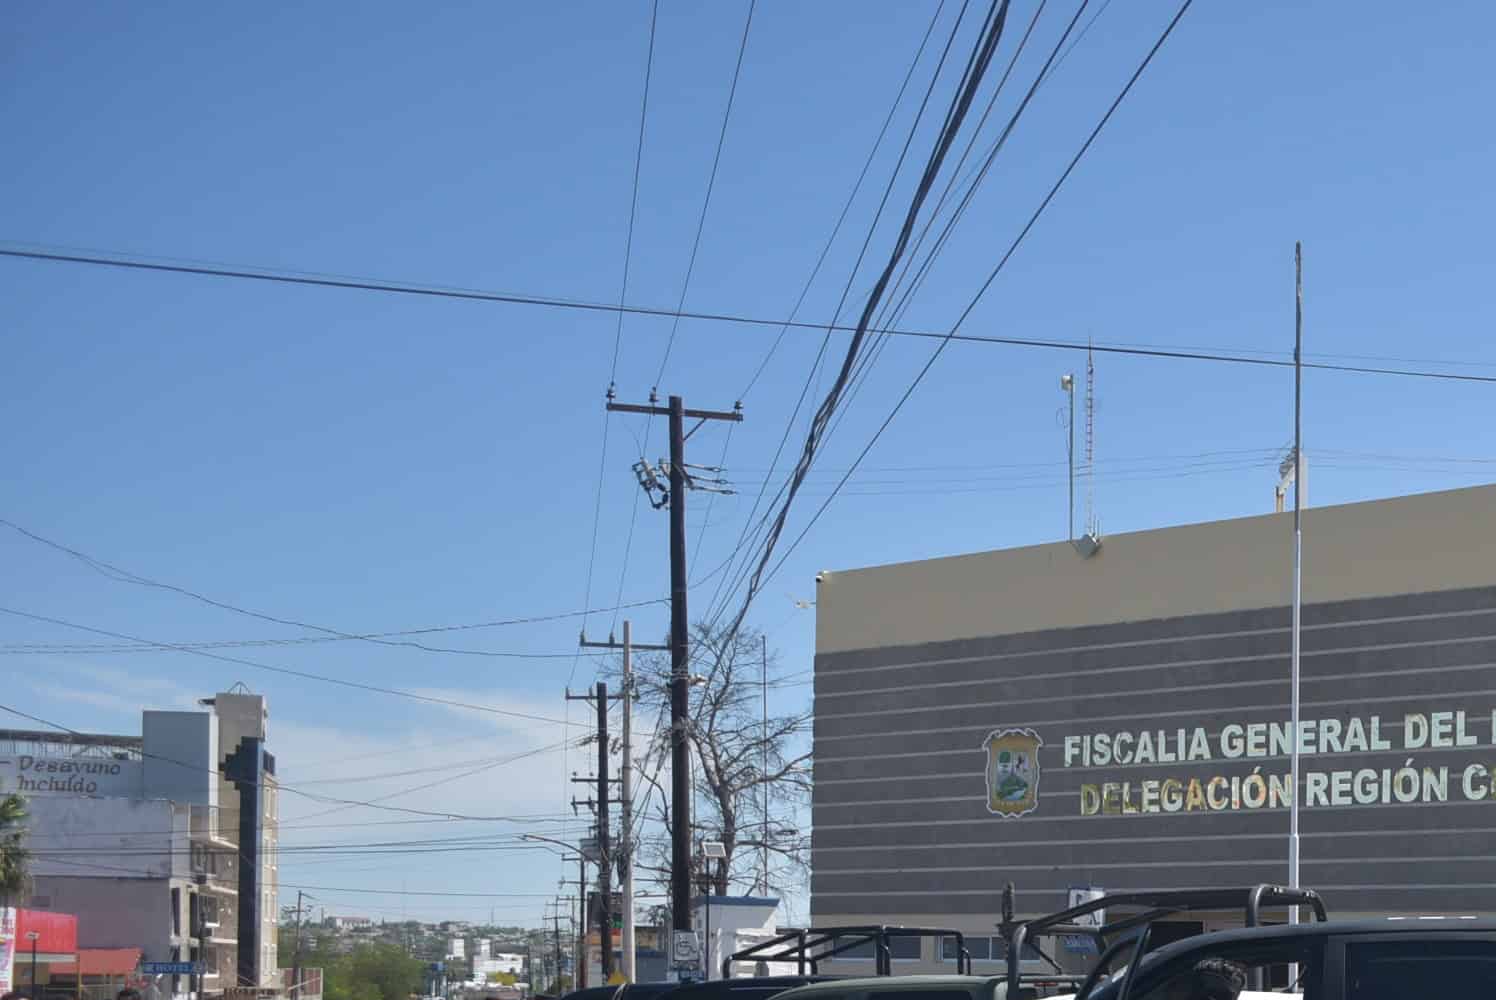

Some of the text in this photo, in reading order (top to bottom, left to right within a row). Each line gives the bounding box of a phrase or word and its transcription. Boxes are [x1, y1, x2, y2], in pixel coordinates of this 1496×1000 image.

[1064, 727, 1212, 768] FISCALIA
[1220, 716, 1391, 759] GENERAL
[1404, 710, 1477, 750] DEL
[1081, 766, 1293, 816] DELEGACIÓN
[1306, 758, 1449, 807] REGIÓN
